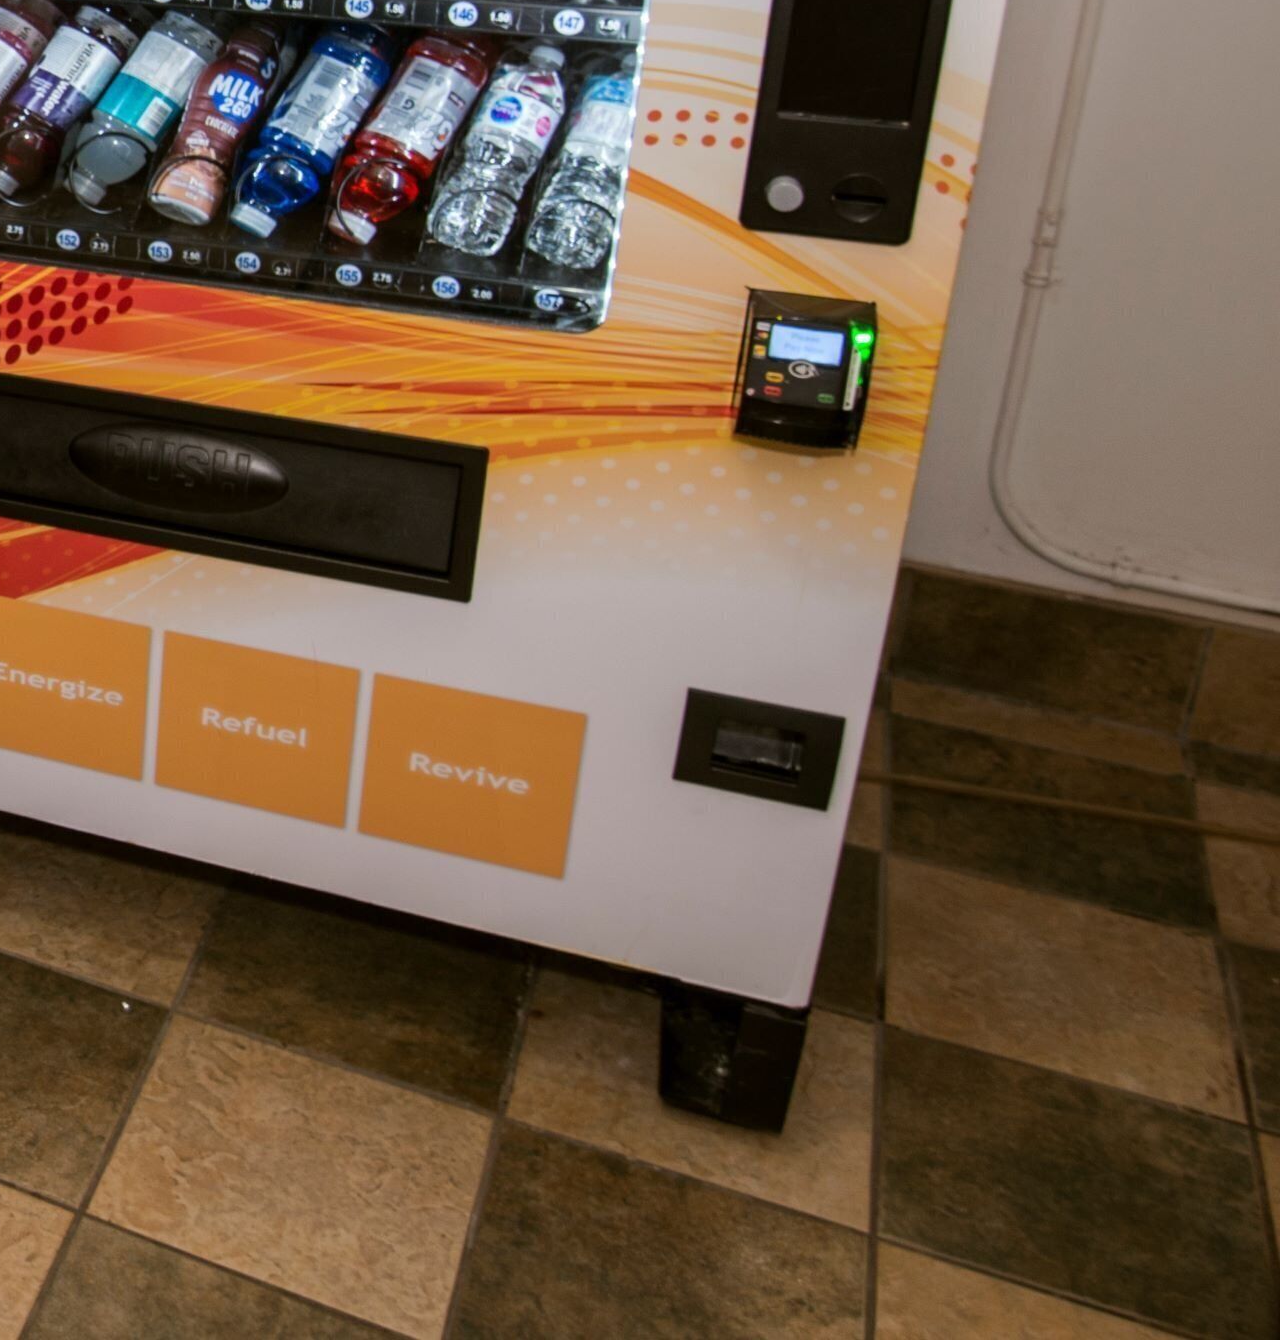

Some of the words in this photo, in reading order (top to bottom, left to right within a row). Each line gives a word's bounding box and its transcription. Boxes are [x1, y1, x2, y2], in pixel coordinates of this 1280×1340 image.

[348, 0, 370, 13] 145
[452, 6, 474, 21] 146
[556, 15, 582, 30] 147
[209, 73, 264, 107] MILK
[219, 96, 252, 119] 2GO
[205, 115, 239, 139] CHOCOLATE
[58, 233, 78, 247] 152
[150, 245, 170, 258] 153
[237, 256, 258, 269] 154
[337, 267, 359, 282] 155
[435, 279, 458, 295] 156
[200, 704, 307, 749] Refuel
[408, 752, 530, 797] Revive
